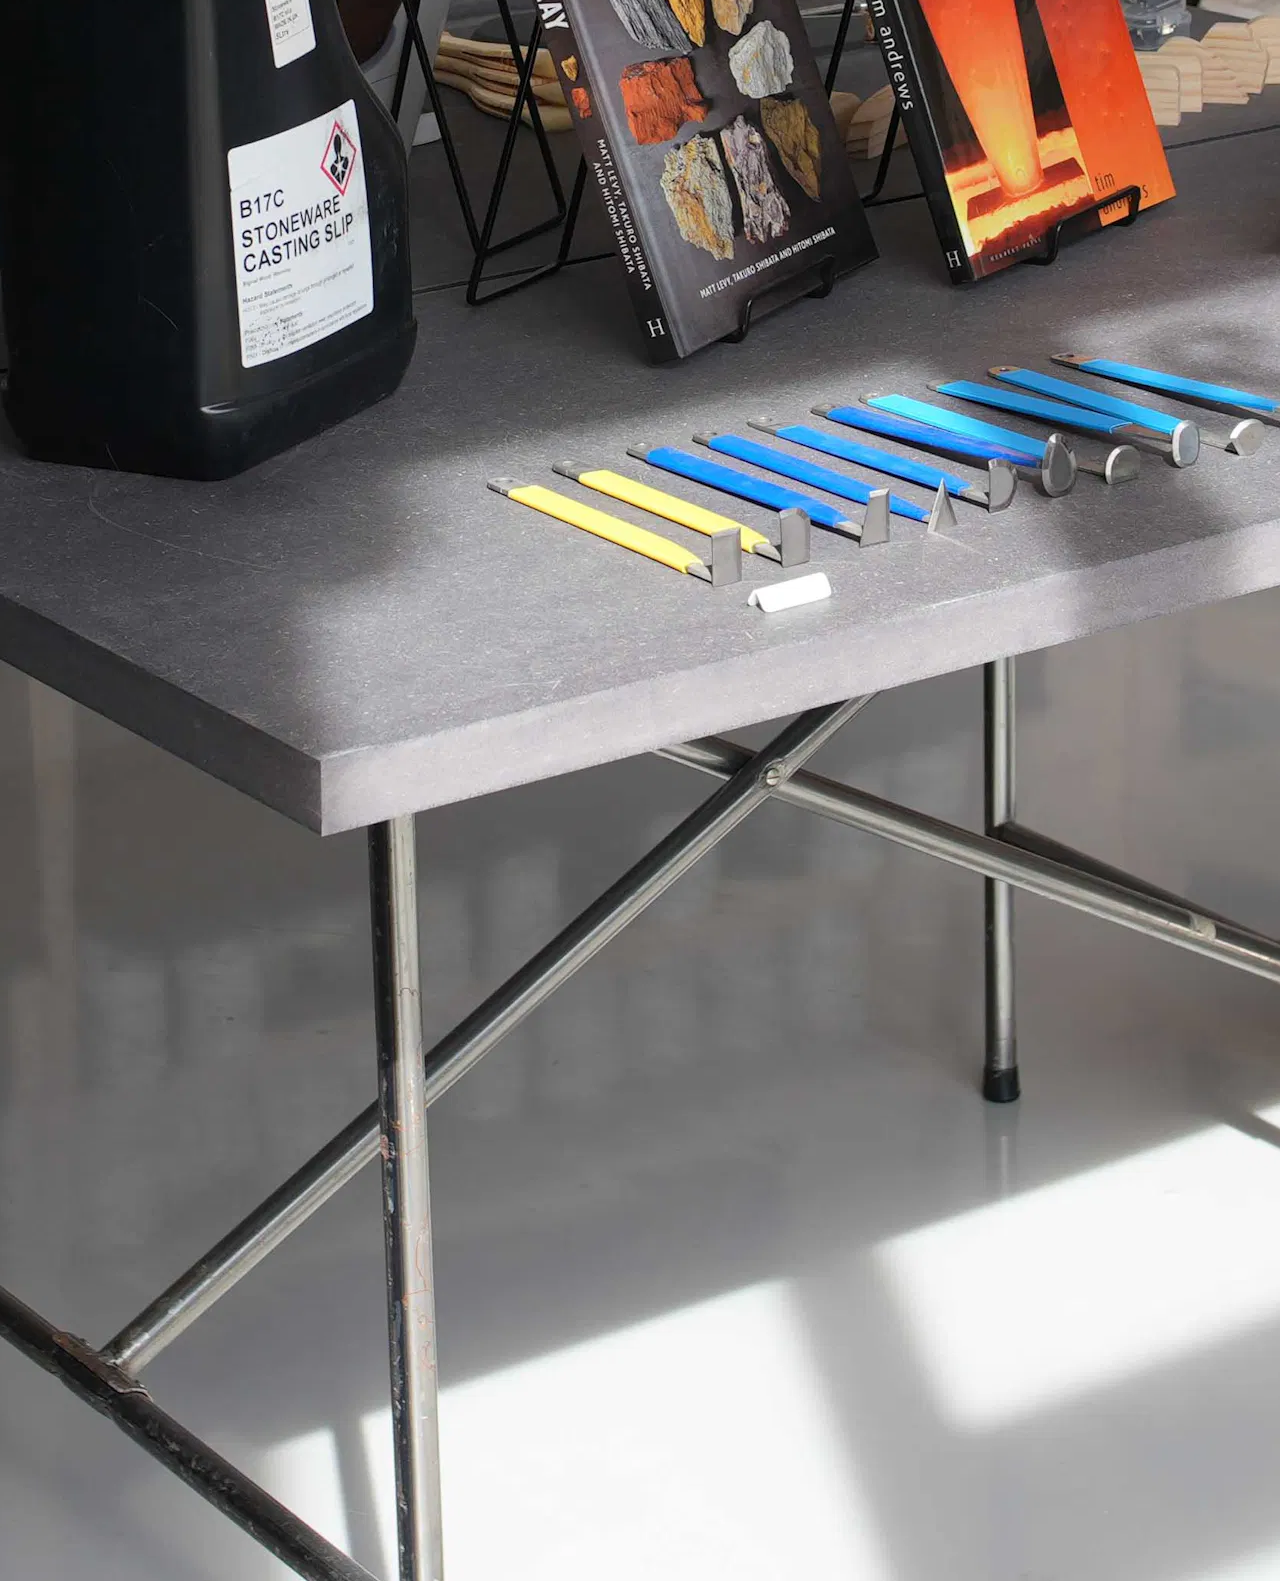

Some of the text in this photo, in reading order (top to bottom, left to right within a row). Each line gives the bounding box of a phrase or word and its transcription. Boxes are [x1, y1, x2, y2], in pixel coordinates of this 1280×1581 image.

[879, 26, 914, 111] andrews
[240, 189, 285, 219] B17C
[1094, 172, 1116, 192] tim
[242, 194, 341, 249] STONEWARE
[593, 162, 635, 274] AND HITOMI SHIBATA
[597, 138, 613, 168] MATT
[617, 200, 637, 244] TAKURO
[633, 245, 653, 291] SHIBATA
[243, 213, 354, 272] CASTING SLIP
[699, 284, 716, 299] MATT
[732, 265, 756, 282] TAKURO
[755, 255, 780, 272] SHIBATA
[779, 247, 793, 261] AND
[792, 240, 813, 255] HITOMI
[812, 226, 836, 243] SHIBATA
[946, 249, 962, 269] H
[242, 283, 293, 304] Hazard Statements
[646, 318, 665, 338] H
